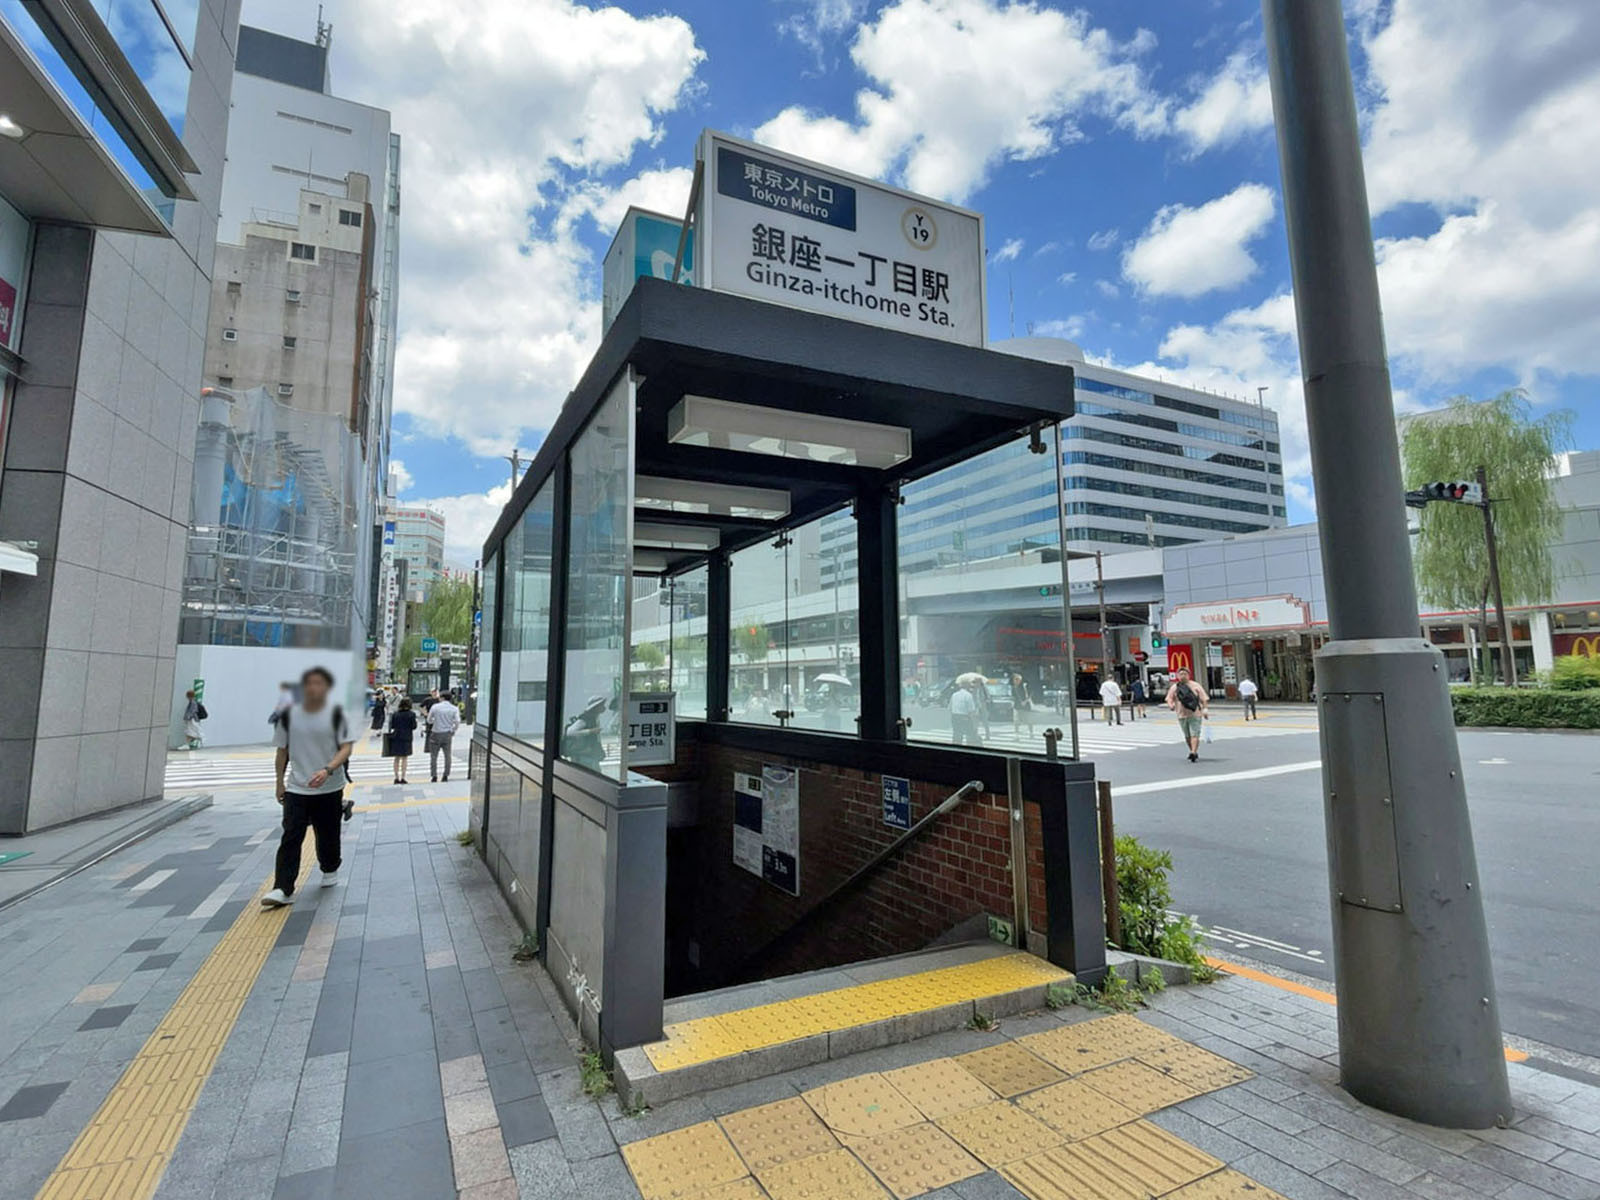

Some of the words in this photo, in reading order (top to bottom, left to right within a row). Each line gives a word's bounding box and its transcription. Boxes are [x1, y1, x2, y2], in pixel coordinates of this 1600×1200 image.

[744, 162, 834, 204] 東京メトロ
[750, 185, 788, 208] Tokyo
[791, 197, 829, 219] Metro
[912, 227, 930, 242] 19
[915, 214, 924, 226] Y
[751, 223, 950, 304] 銀座一丁目駅
[746, 262, 911, 318] Ginza-itchome
[918, 303, 955, 327] Sta.
